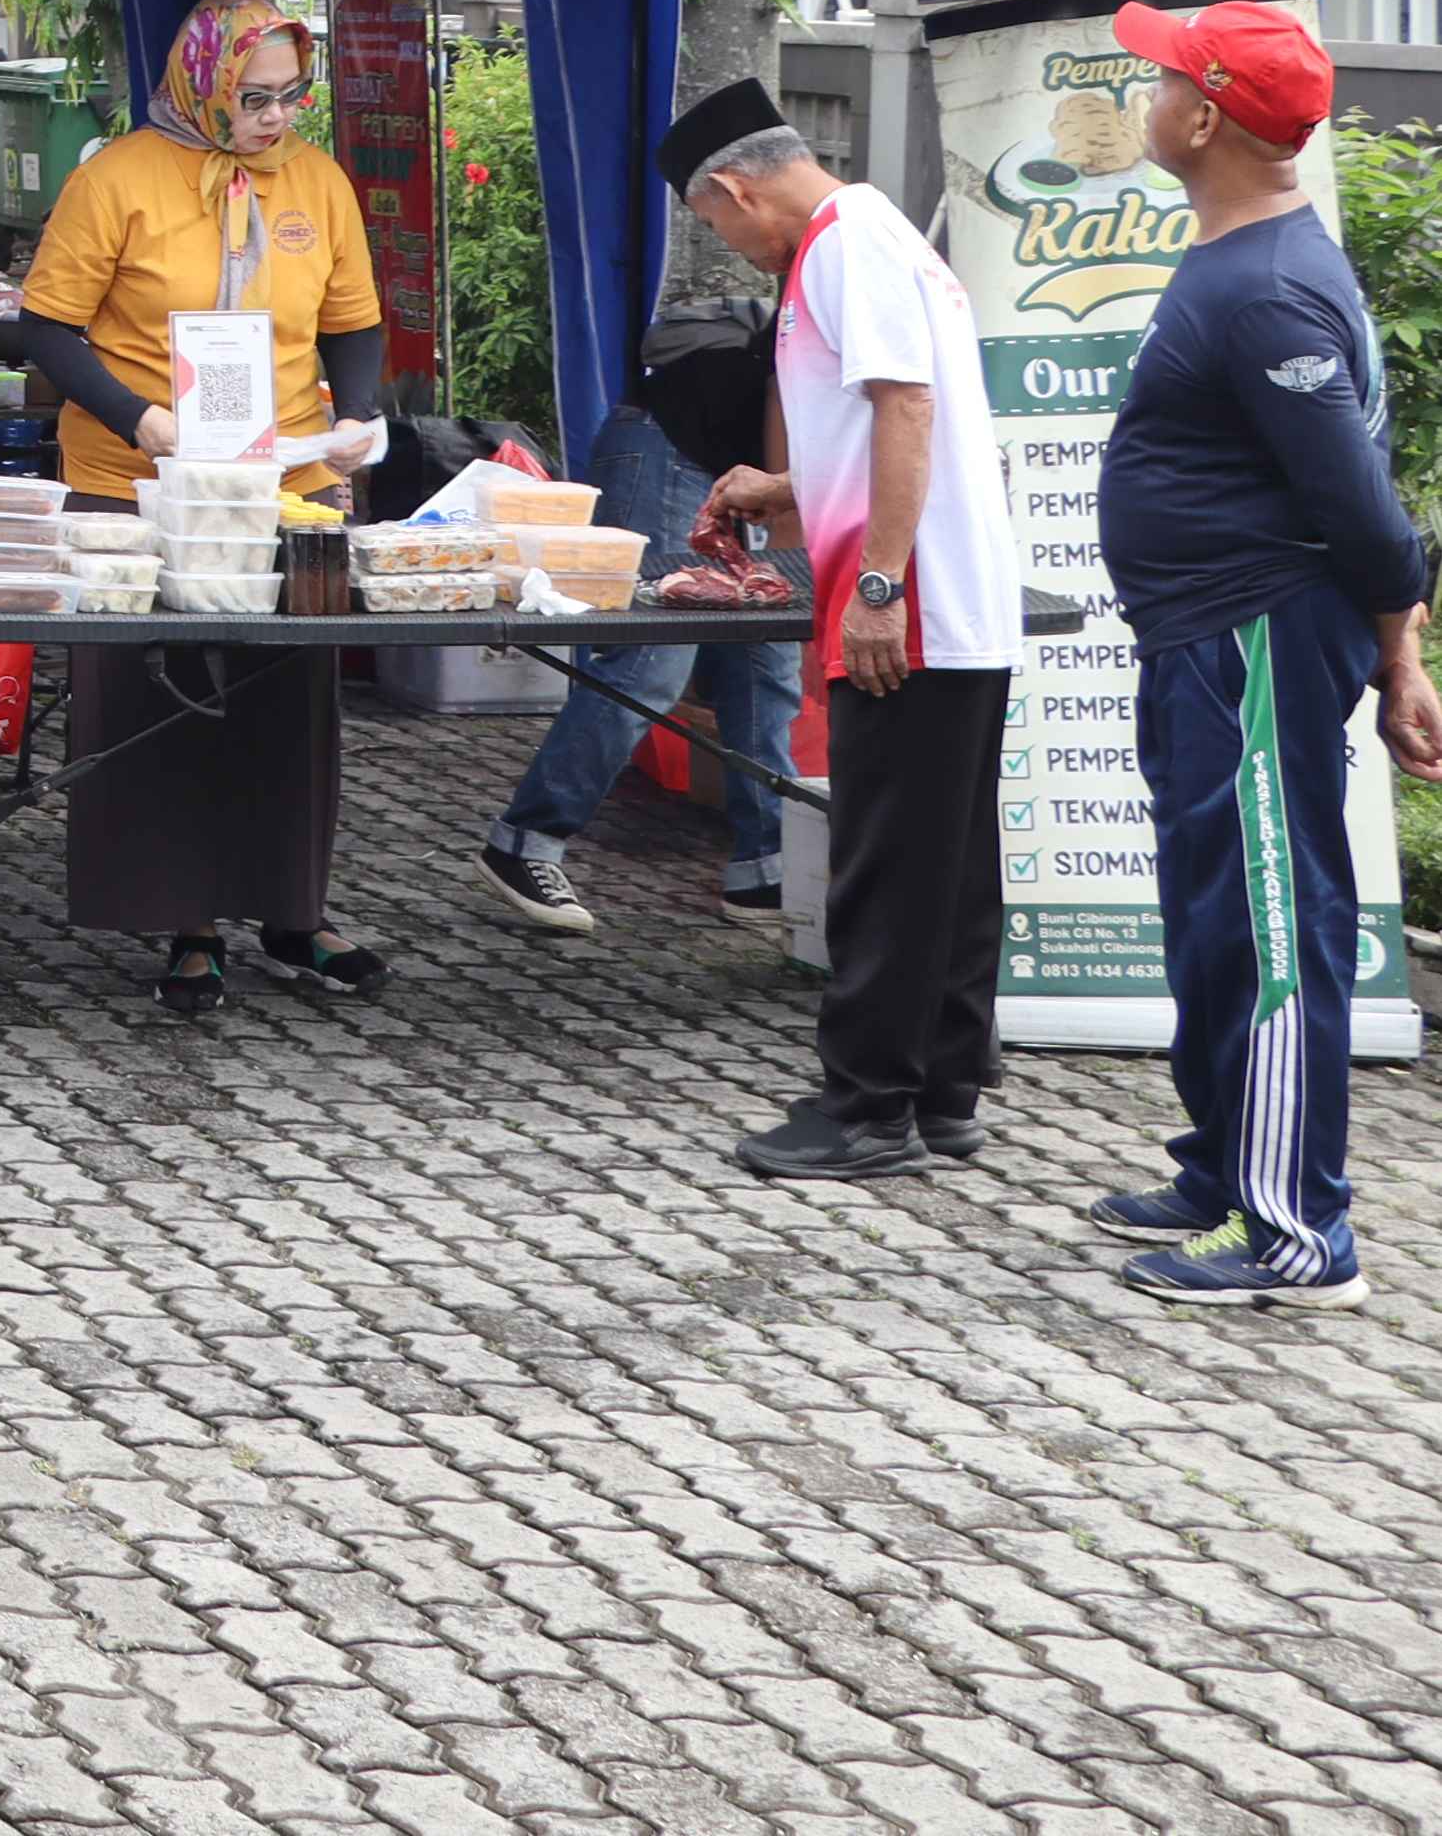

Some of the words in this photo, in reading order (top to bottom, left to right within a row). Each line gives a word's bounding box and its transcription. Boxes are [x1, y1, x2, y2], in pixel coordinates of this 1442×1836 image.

[1023, 357, 1117, 399] Our
[1043, 695, 1136, 721] PEMPE
[1054, 851, 1158, 876] SIOMAY
[1037, 912, 1074, 925] Bumi
[1076, 912, 1138, 928] Cibinong
[1038, 927, 1070, 939] Blok
[1122, 927, 1138, 939] 13
[1039, 942, 1099, 955] Sukahati
[1102, 942, 1165, 957] Cibinong
[1040, 964, 1080, 978] 0813
[1084, 964, 1122, 978] 1434
[1125, 964, 1165, 978] 4630
